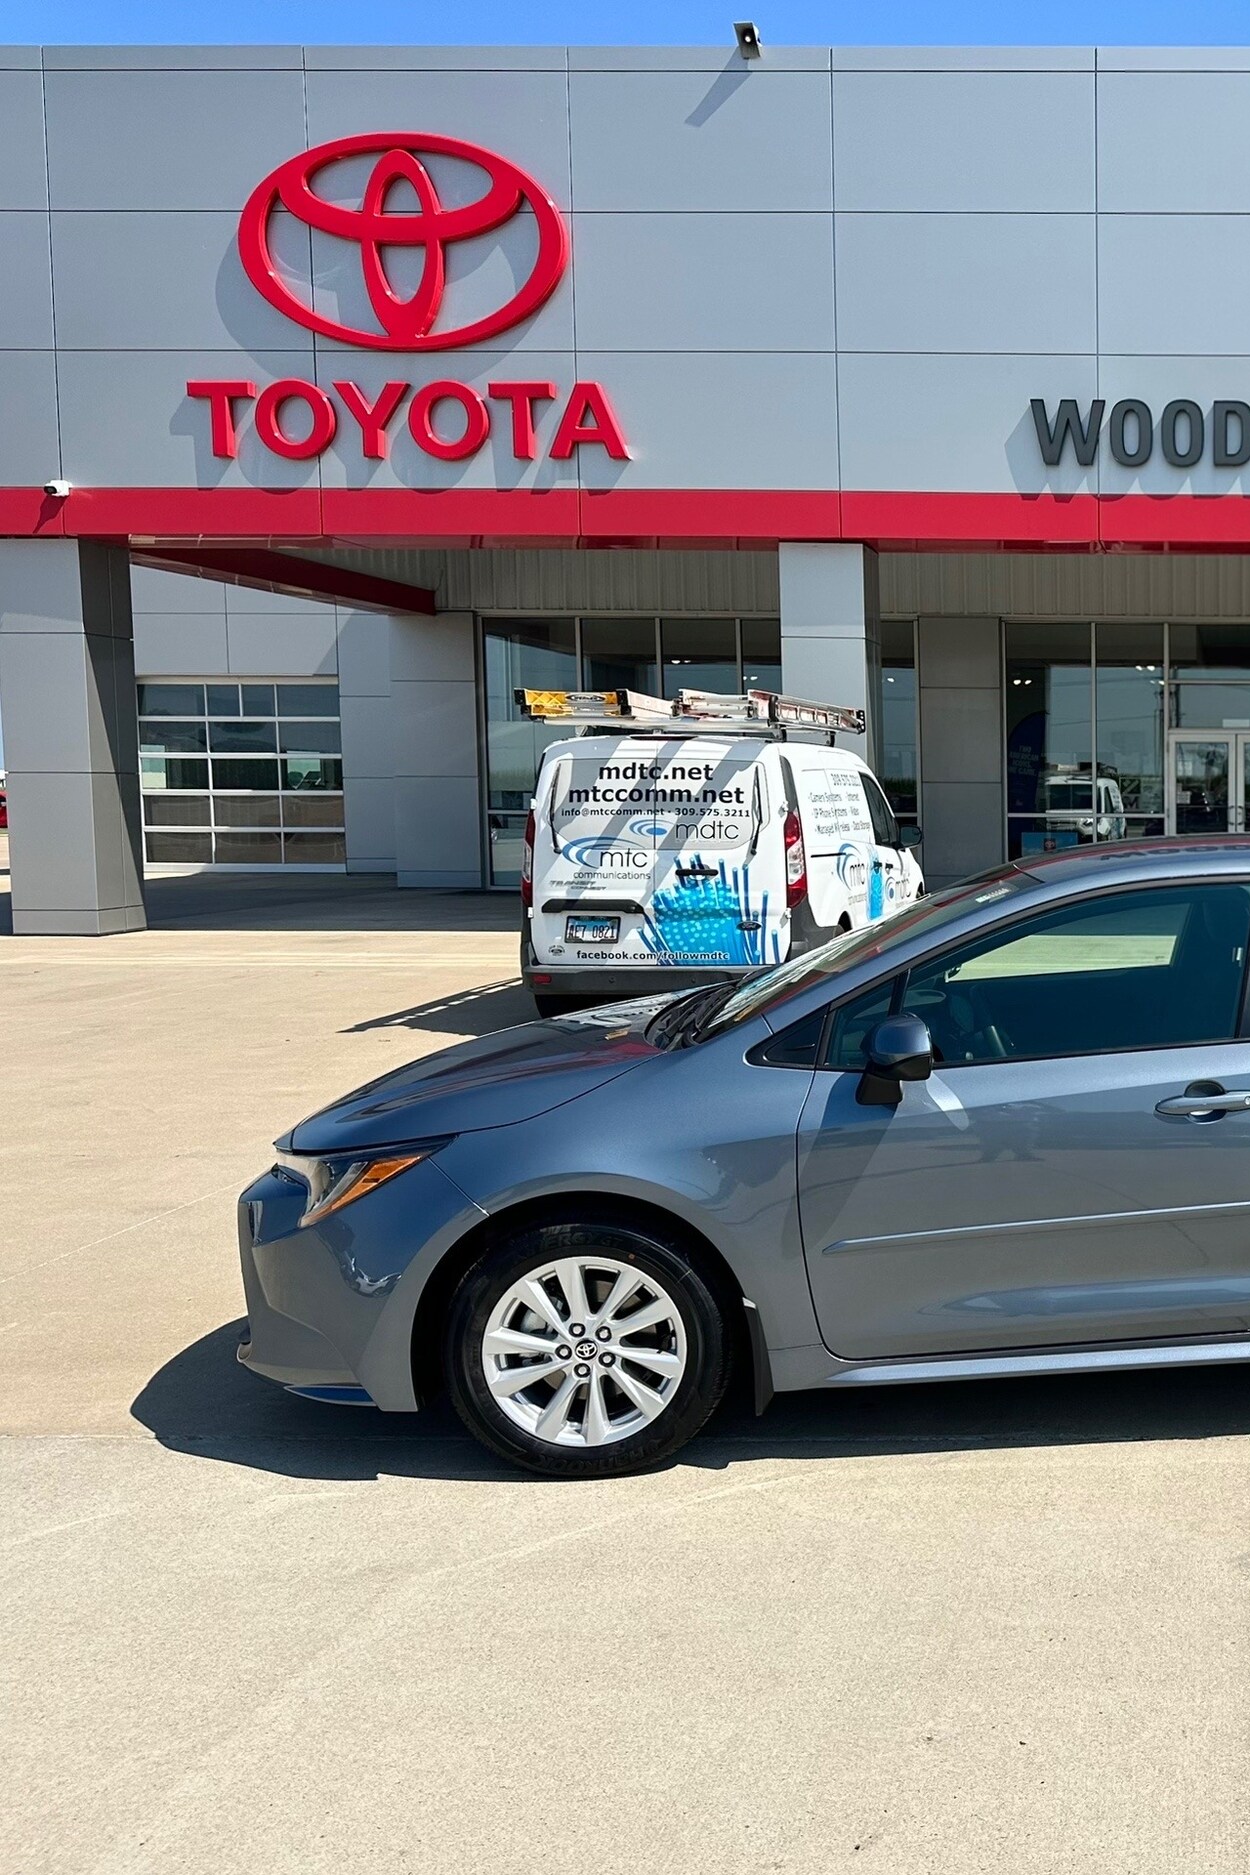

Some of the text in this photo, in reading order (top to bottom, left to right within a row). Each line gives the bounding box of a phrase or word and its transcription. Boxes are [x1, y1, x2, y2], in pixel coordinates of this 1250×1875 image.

[186, 379, 633, 462] TOYOTA
[599, 762, 714, 781] mdtc.net
[569, 786, 745, 804] mtccomm.net
[561, 807, 750, 818] info@mtccomm.net 309.575.3211
[676, 820, 739, 839] mdtc
[599, 849, 648, 868] mtc
[573, 871, 651, 880] communications
[592, 925, 615, 939] 0821
[576, 950, 730, 961] facebook.com/followmdtc
